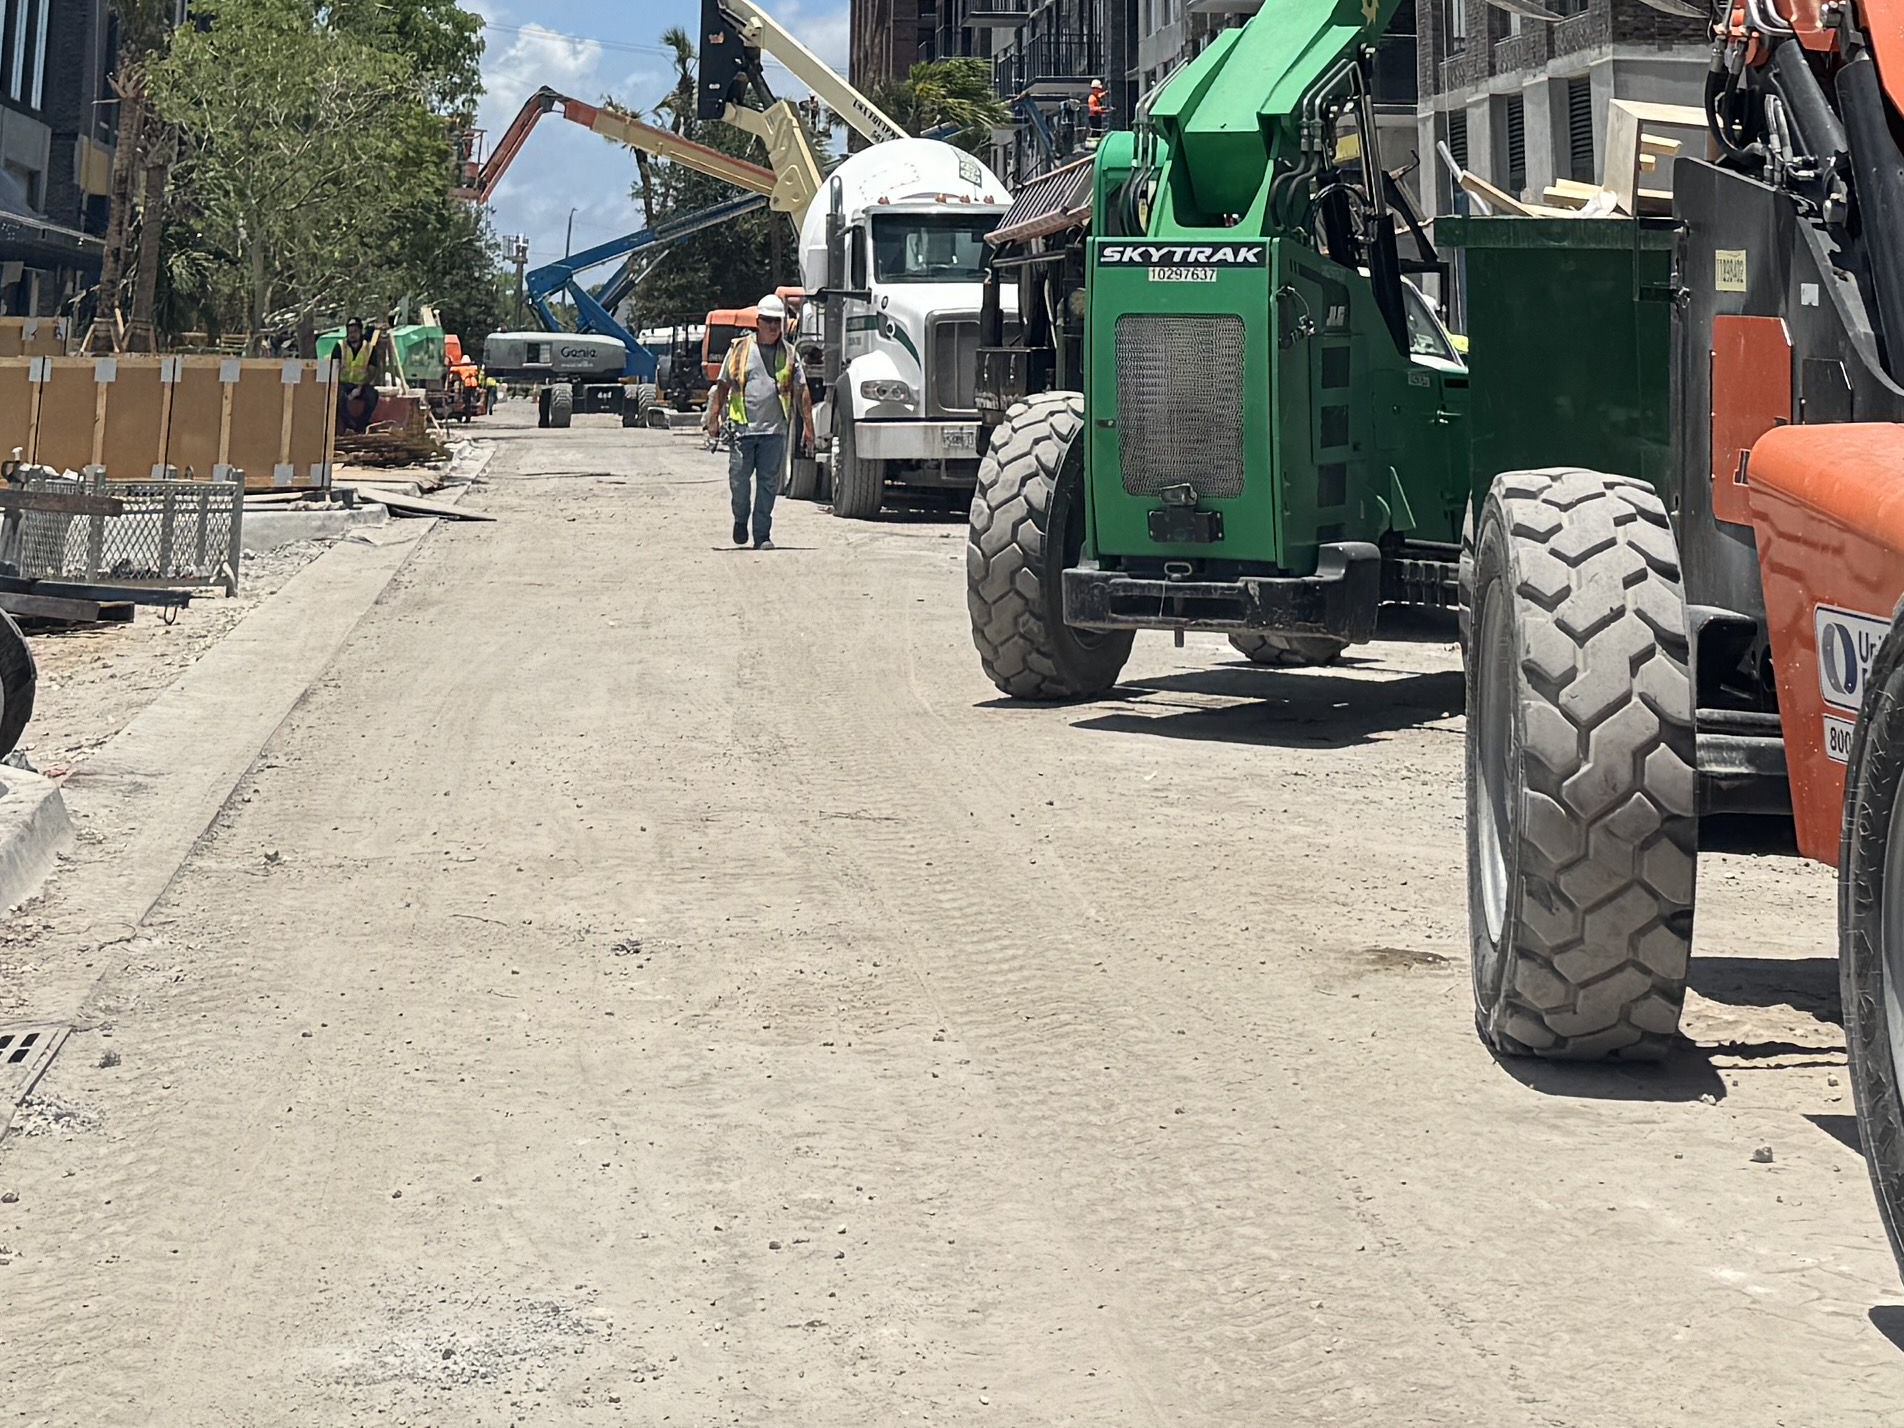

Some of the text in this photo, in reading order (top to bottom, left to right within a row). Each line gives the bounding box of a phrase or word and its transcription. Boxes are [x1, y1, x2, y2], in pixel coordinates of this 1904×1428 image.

[1100, 246, 1264, 263] SKYTRAK
[1150, 267, 1216, 281] 10297637
[560, 346, 598, 358] Genie
